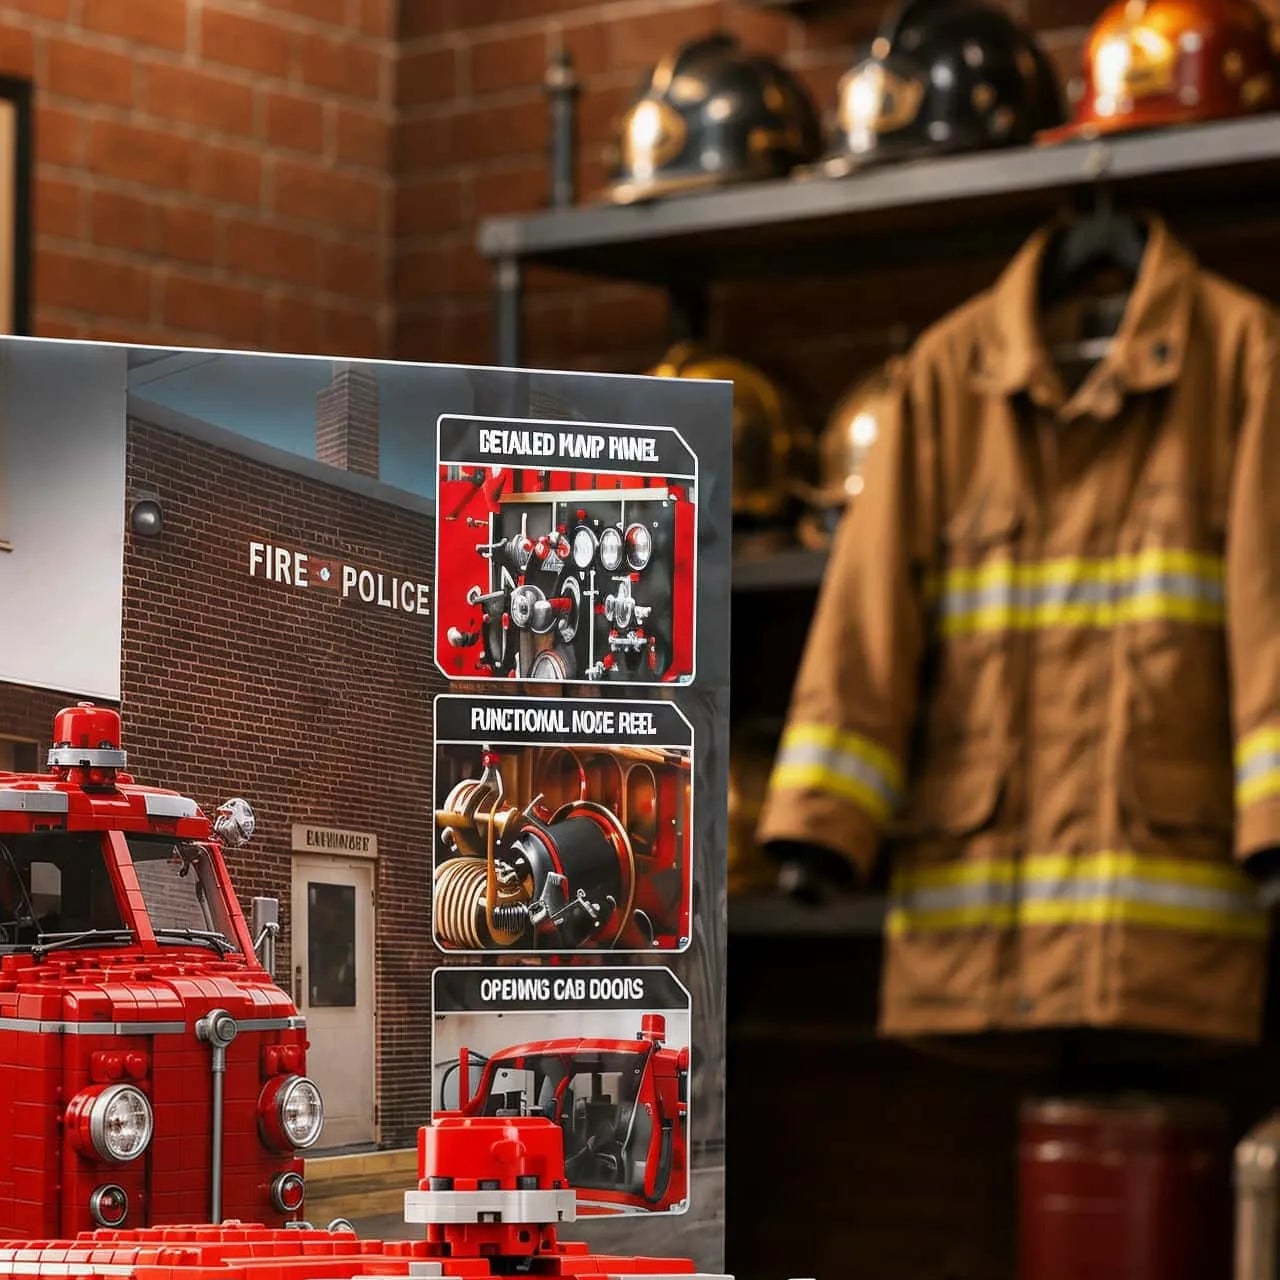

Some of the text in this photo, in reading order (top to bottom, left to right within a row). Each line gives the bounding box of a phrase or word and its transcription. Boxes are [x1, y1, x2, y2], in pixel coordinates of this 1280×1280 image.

[249, 541, 430, 616] FIRE POLICE
[553, 977, 586, 1000] CAB
